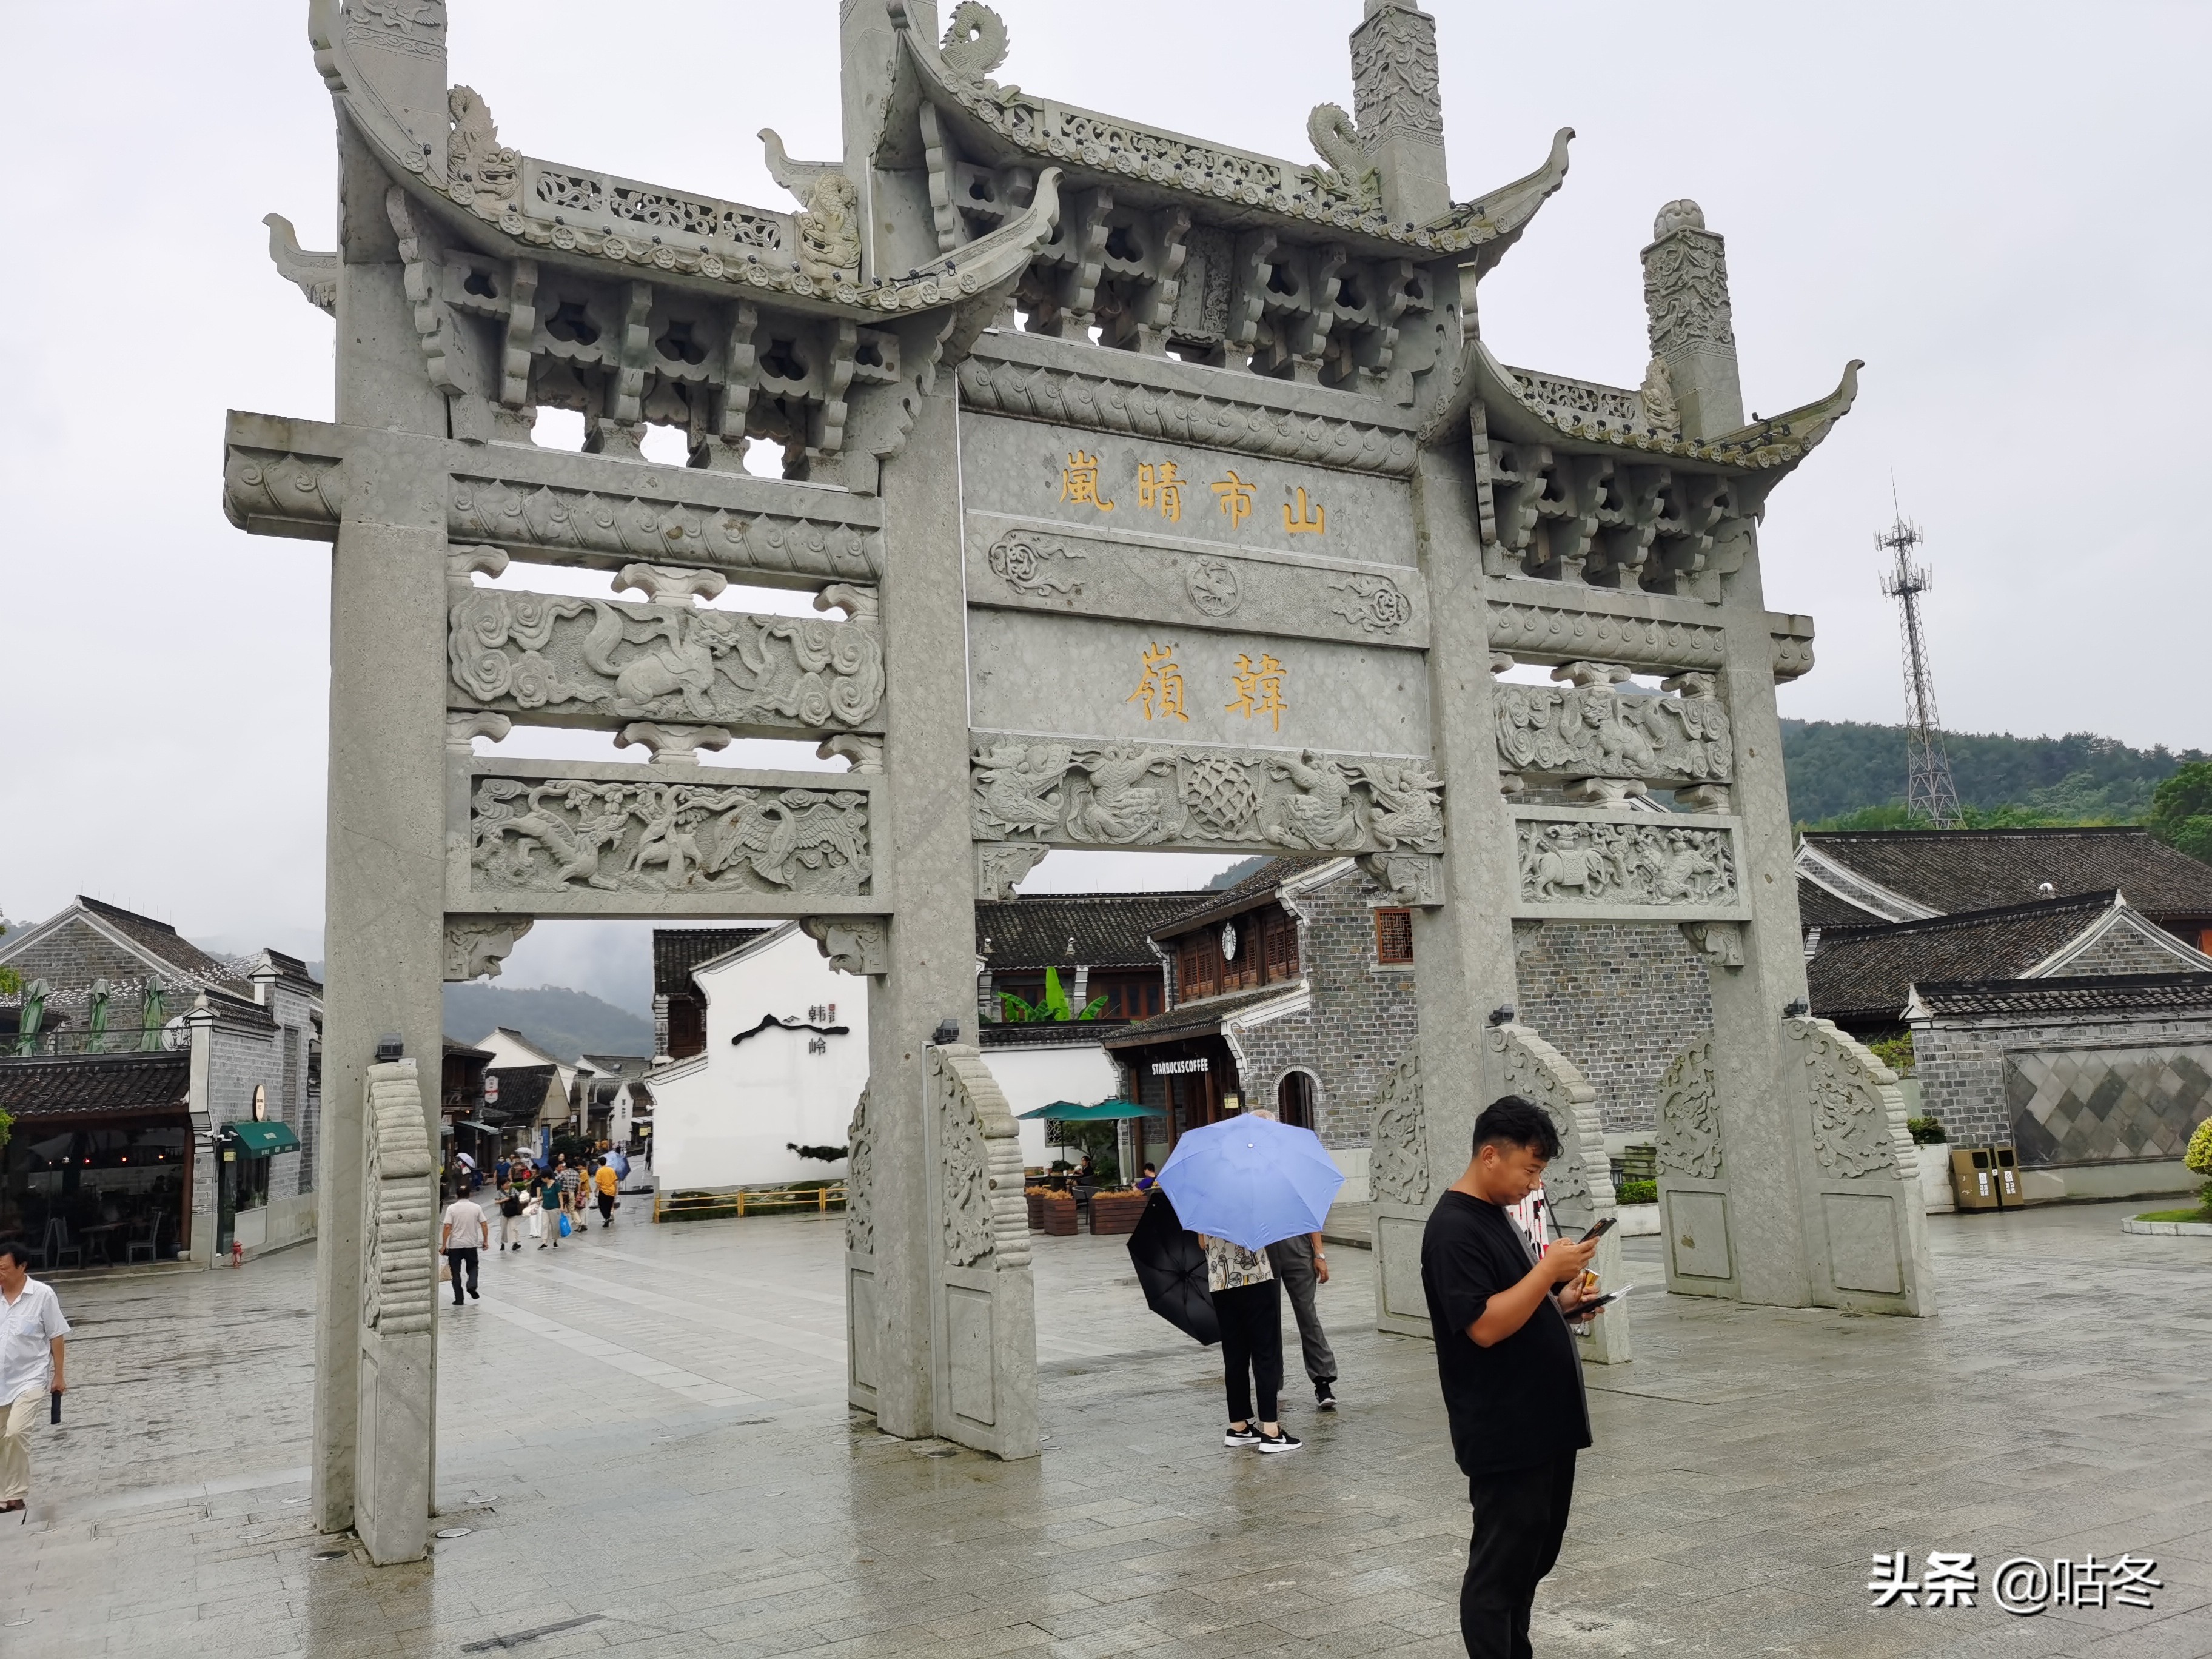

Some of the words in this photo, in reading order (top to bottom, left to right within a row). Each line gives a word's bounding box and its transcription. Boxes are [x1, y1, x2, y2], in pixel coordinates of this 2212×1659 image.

[808, 1004, 826, 1055] 韩岭
[1152, 1061, 1185, 1075] STARBUCKS
[1185, 1058, 1208, 1073] COFFEE
